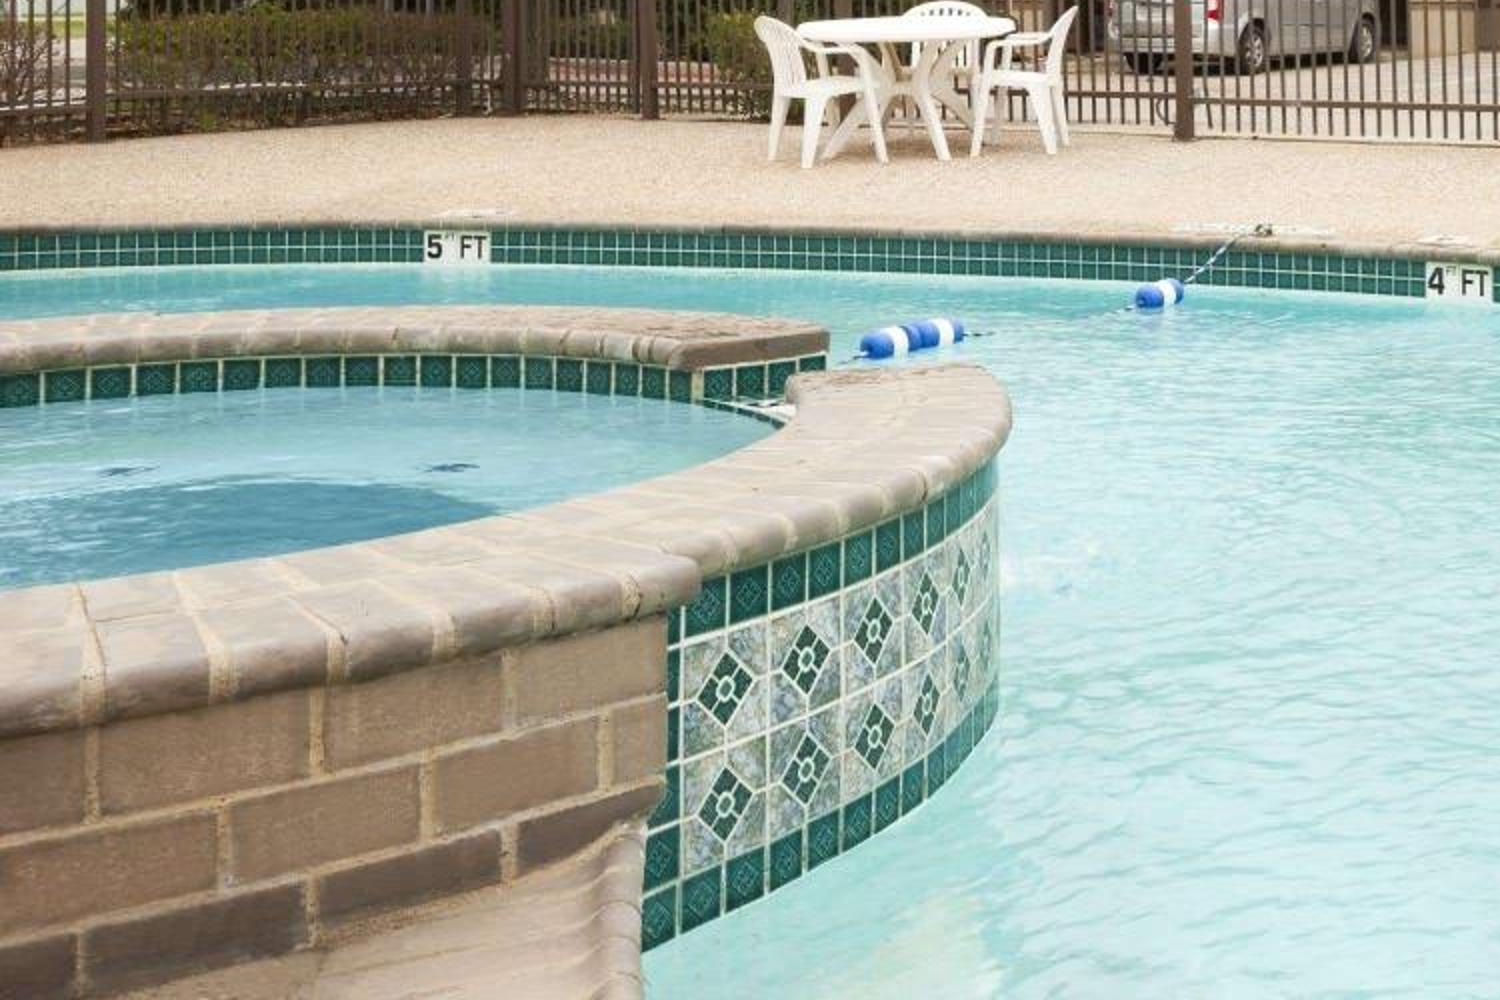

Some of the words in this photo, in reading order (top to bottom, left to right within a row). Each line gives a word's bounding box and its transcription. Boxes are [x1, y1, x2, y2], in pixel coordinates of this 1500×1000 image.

[427, 234, 442, 259] 5
[461, 235, 487, 259] FT
[1428, 267, 1445, 295] 4
[1462, 269, 1488, 296] FT
